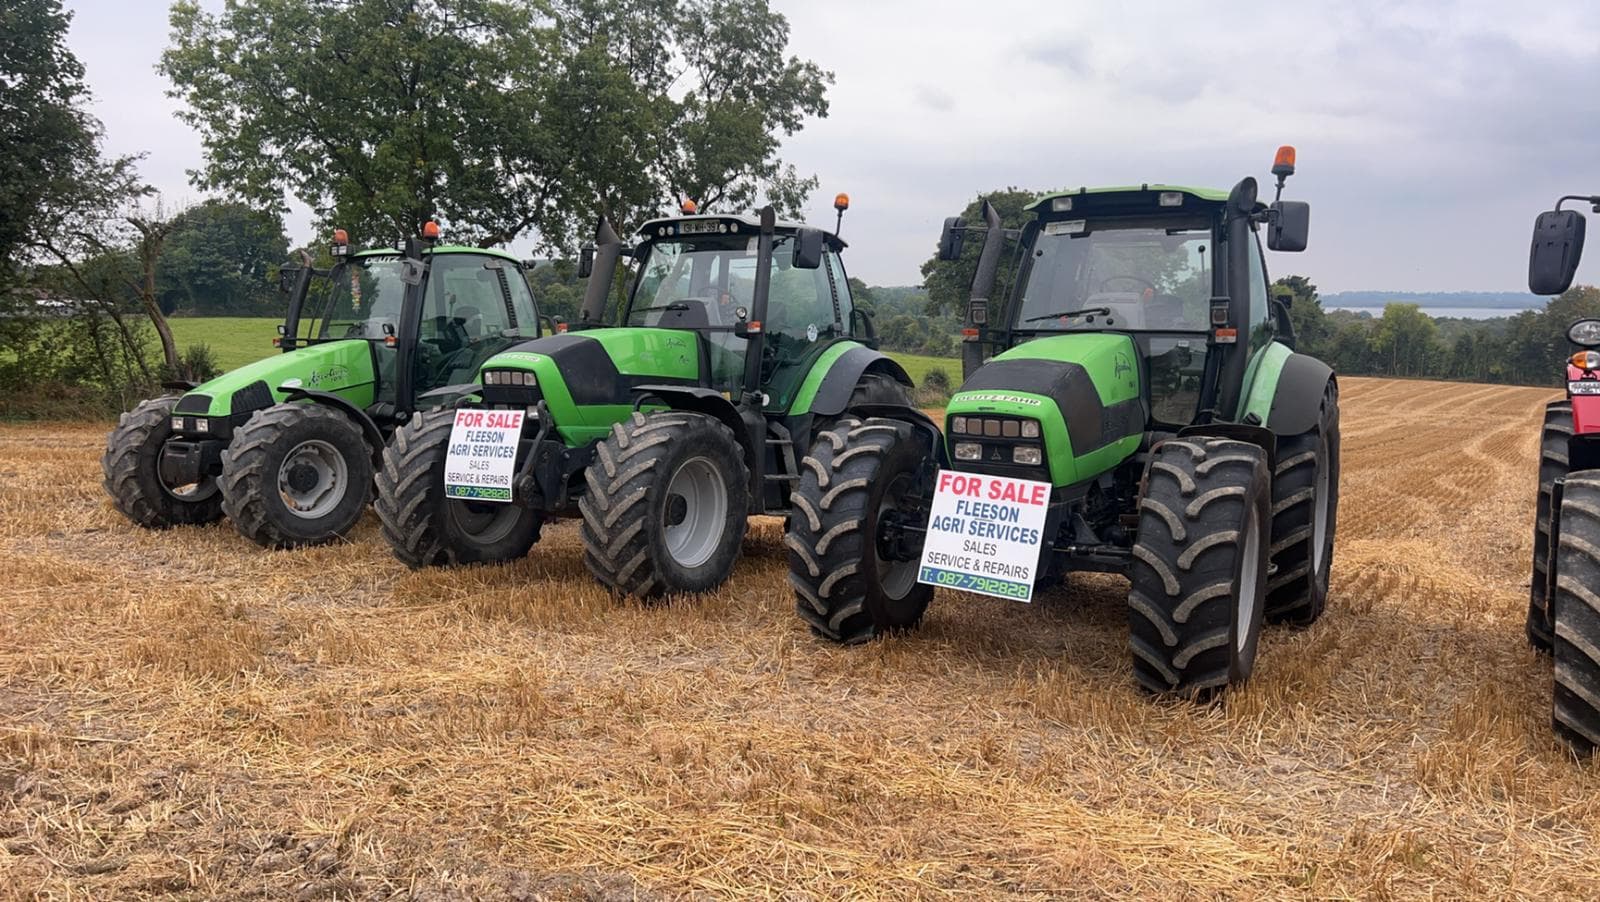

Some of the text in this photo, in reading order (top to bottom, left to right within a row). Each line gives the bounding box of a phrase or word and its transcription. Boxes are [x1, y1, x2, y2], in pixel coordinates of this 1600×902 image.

[364, 255, 401, 265] DEUTZ
[958, 395, 1040, 405] DEUTZ-FAHR
[456, 412, 521, 428] FOR SALE
[465, 430, 505, 443] FLEESON
[449, 444, 515, 458] AGRI SERVICES
[469, 460, 490, 470] SALES
[447, 472, 509, 485] SERVICE & REPAIRS
[455, 486, 509, 498] 087-7912828
[939, 474, 1046, 506] FOR SALE
[956, 500, 1020, 523] FLEESON
[932, 515, 1039, 545] AGRI SERVICES
[963, 539, 997, 556] SALES
[927, 551, 1030, 580] SERVICE & REPAIRS
[923, 568, 1028, 598] T: 087-7912828
